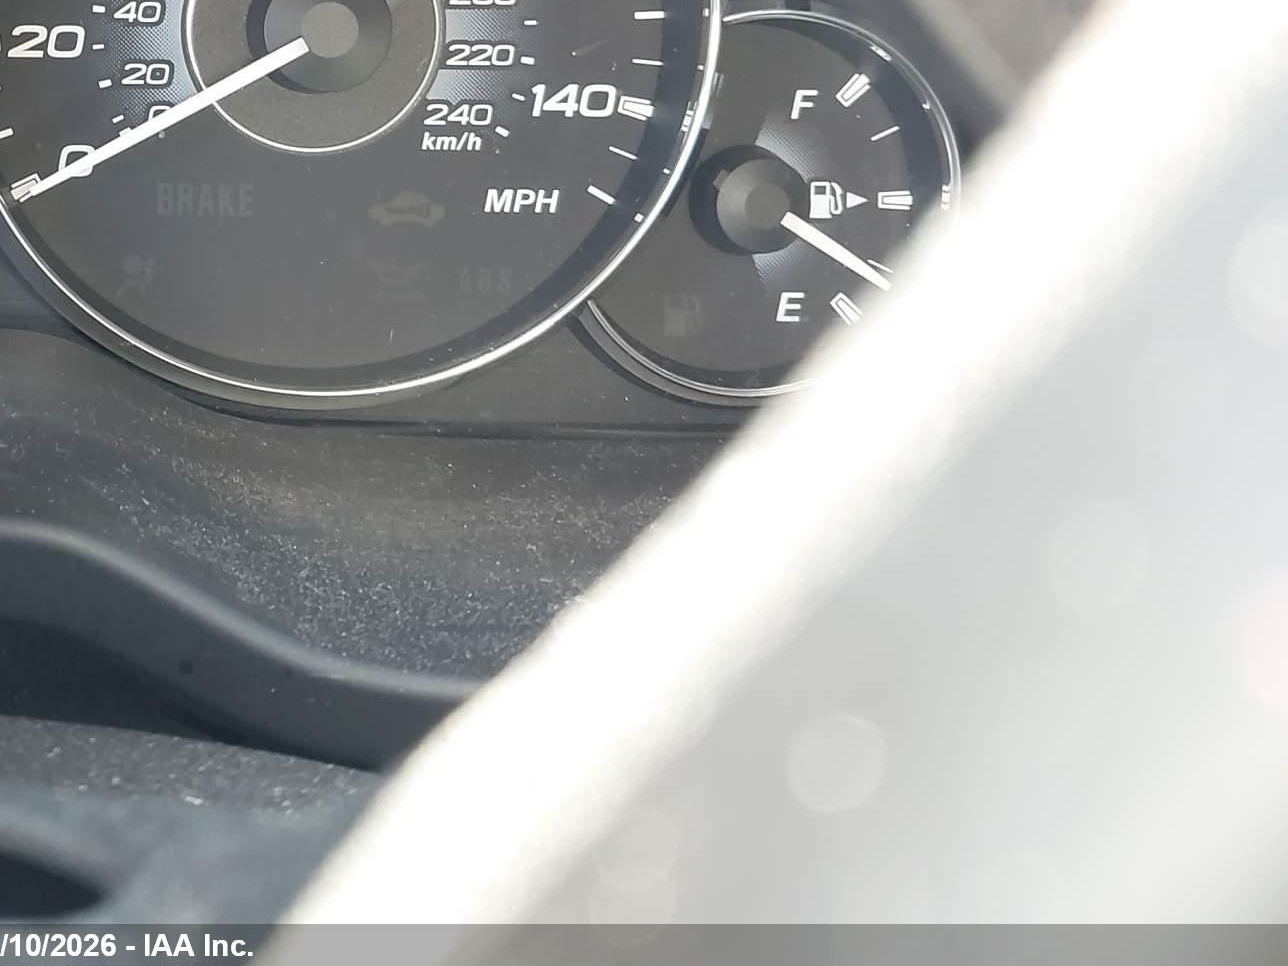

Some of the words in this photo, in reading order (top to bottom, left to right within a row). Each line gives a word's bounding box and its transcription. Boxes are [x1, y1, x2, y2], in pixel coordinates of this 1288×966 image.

[113, 1, 162, 24] 40
[7, 25, 85, 60] 20
[447, 43, 516, 67] 220
[120, 63, 171, 85] 20
[530, 83, 616, 119] 140
[791, 90, 818, 120] F
[424, 103, 492, 126] 240
[421, 132, 482, 152] km/h
[156, 183, 255, 218] BRAKE
[484, 189, 559, 214] MPH
[775, 291, 805, 322] E
